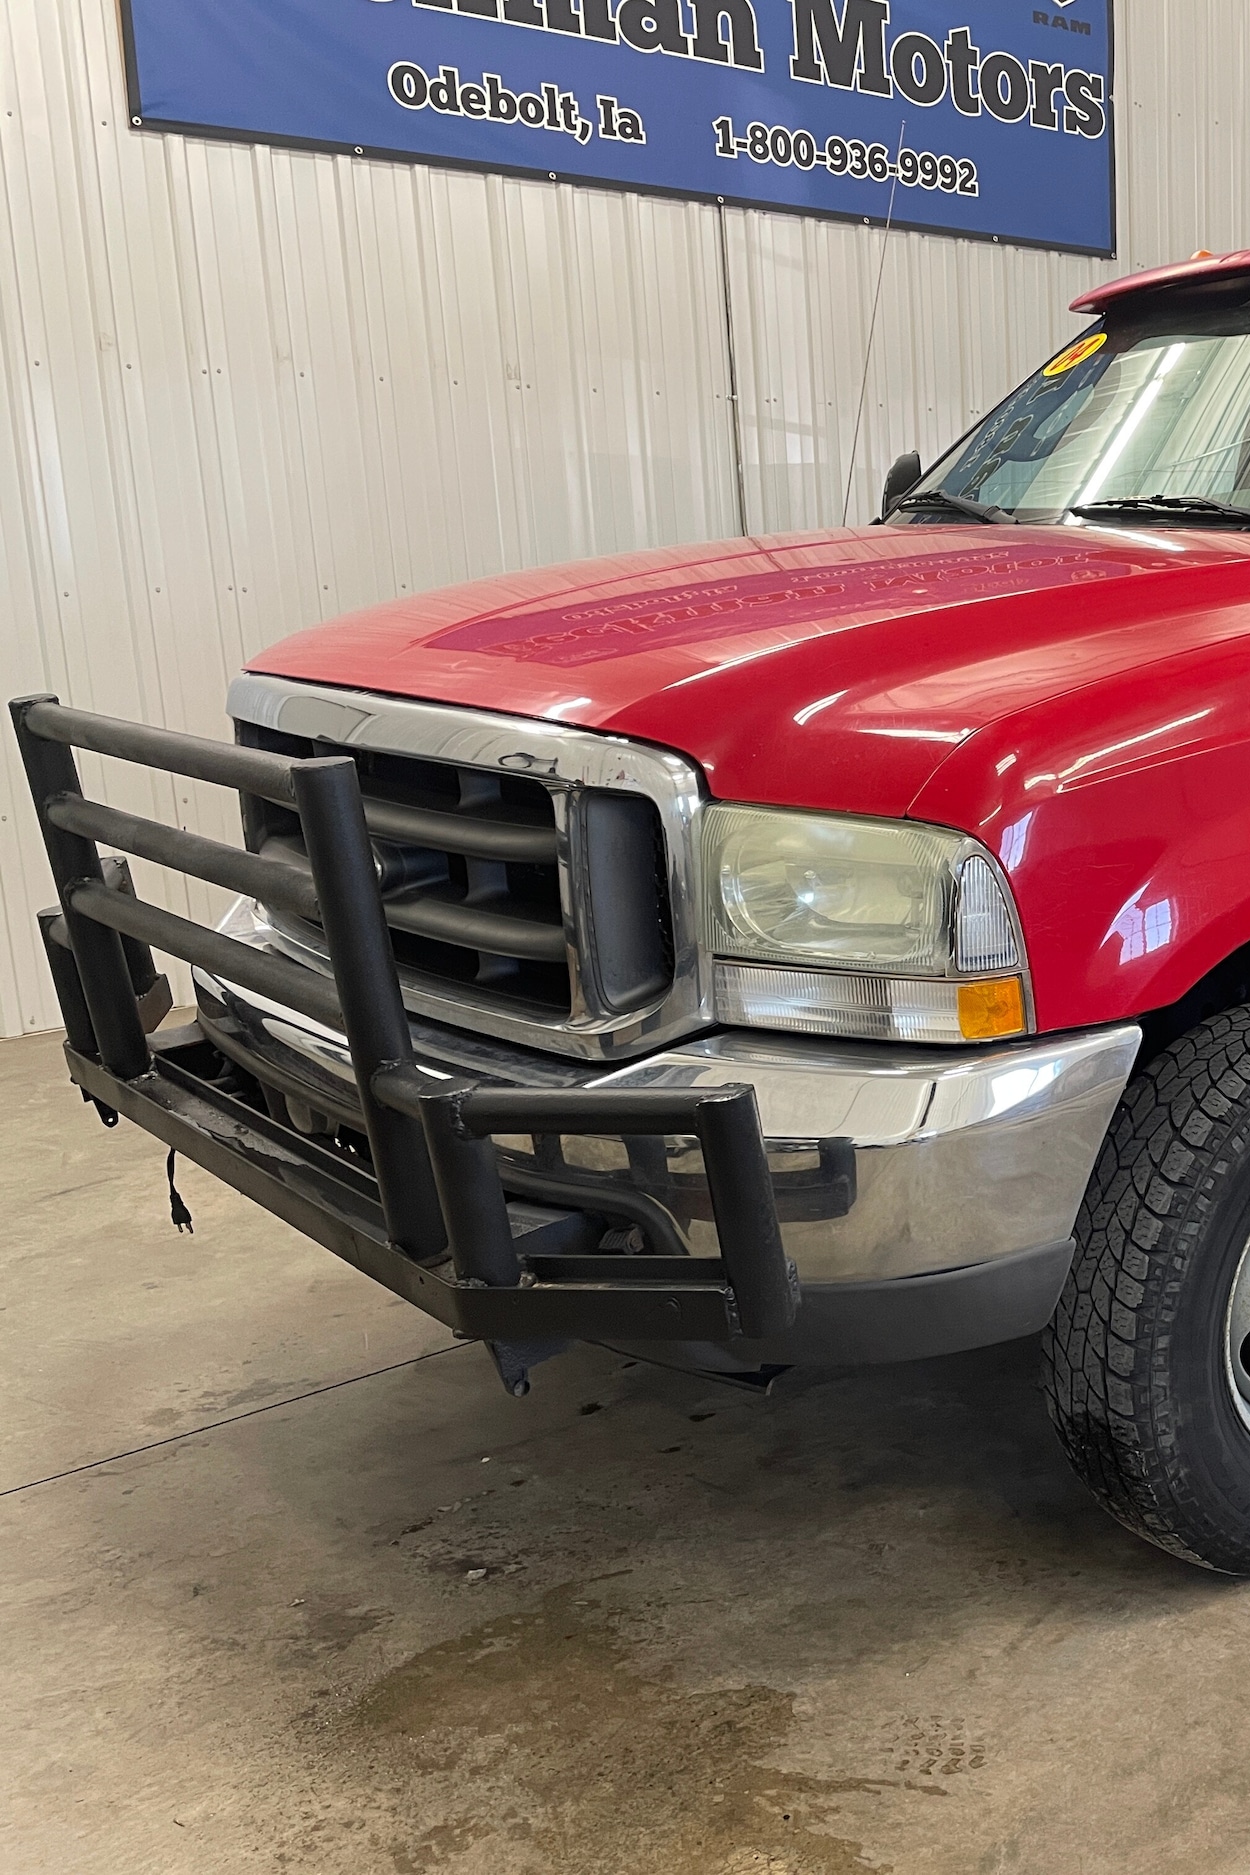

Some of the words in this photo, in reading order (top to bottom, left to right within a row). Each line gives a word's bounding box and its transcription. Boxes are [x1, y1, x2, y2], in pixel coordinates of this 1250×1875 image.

[1032, 10, 1091, 36] RAM
[387, 61, 591, 145] Odebolt,
[597, 94, 646, 144] Ia
[789, 0, 1106, 139] Motors
[712, 116, 980, 197] 1-800-936-9992
